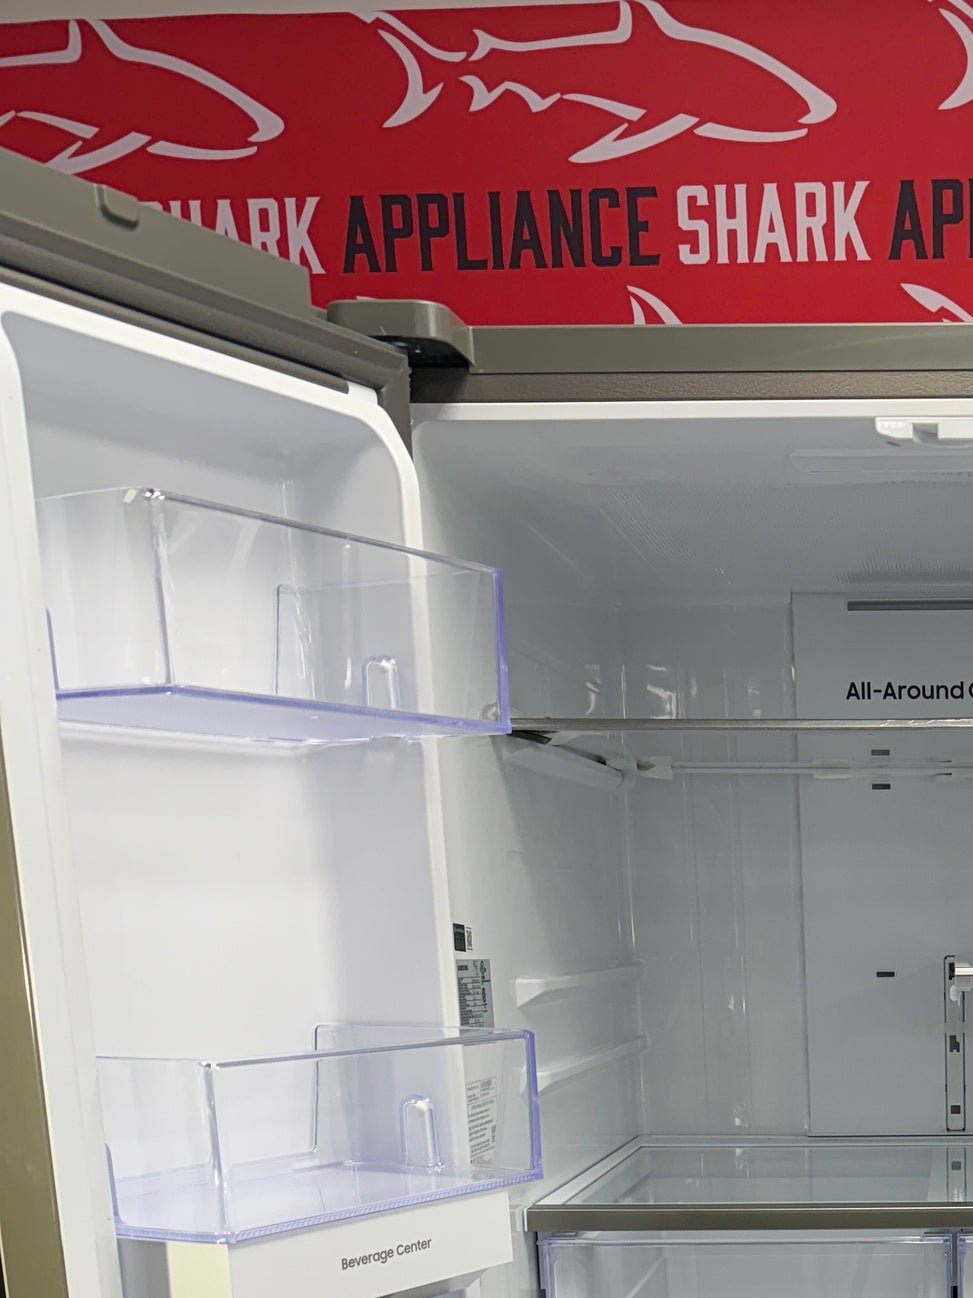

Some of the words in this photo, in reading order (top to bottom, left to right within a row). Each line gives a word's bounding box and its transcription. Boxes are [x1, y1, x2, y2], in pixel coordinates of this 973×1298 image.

[342, 187, 660, 274] APPLIANCE
[677, 180, 871, 265] SHARK
[846, 681, 965, 700] All-Around
[341, 1248, 394, 1270] Beverage
[396, 1239, 432, 1256] Center
